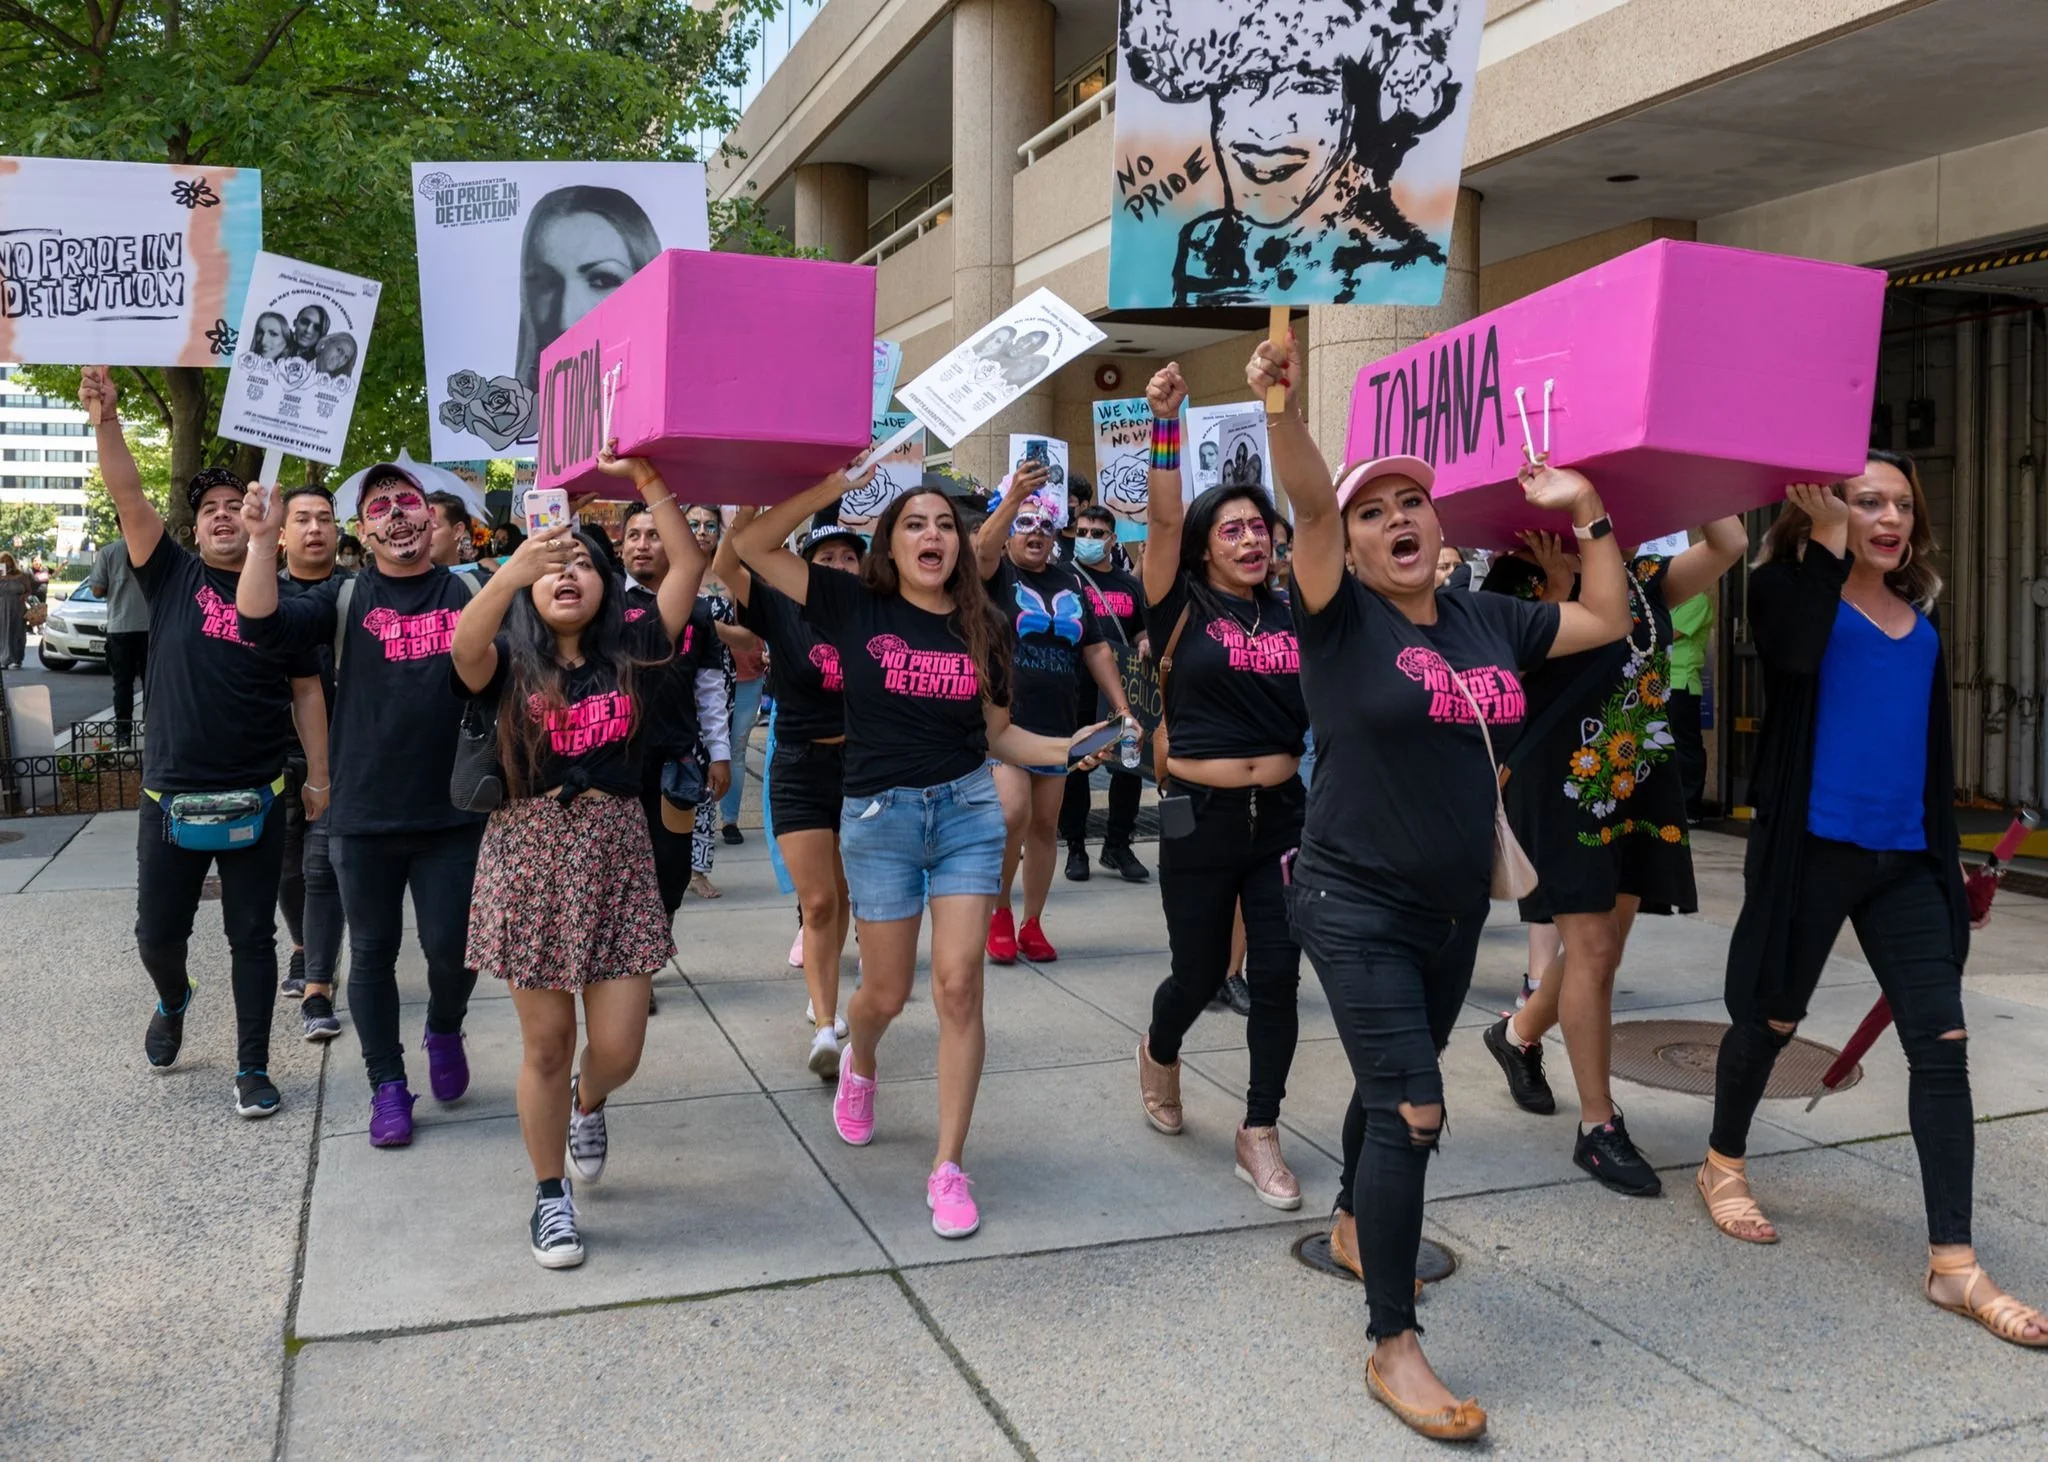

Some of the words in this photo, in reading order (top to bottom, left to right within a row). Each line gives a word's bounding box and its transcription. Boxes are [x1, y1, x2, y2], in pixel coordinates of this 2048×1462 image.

[1116, 153, 1154, 195] NO
[1123, 145, 1211, 223] PRIDE
[436, 190, 454, 206] NO
[457, 184, 499, 204] PRIDE
[502, 182, 517, 199] IN
[436, 199, 517, 224] DETENTION
[40, 236, 138, 279] PRIDE
[142, 232, 182, 271] IN
[1, 271, 184, 318] DETENTION
[1097, 404, 1121, 420] WE
[1127, 402, 1150, 414] WA
[233, 424, 332, 454] #ENDTRANSDETENTION
[202, 615, 239, 638] DETE
[380, 622, 401, 641] NO
[402, 614, 445, 638] PRIDE
[385, 630, 455, 659] DETENTIO
[1223, 632, 1244, 648] NO
[821, 659, 838, 674] NO
[880, 651, 907, 669] NO
[908, 655, 960, 675] PRIDE
[1229, 648, 1300, 670] DETENTIO
[885, 669, 978, 696] DETENTION
[1424, 668, 1449, 691] NO
[1497, 670, 1521, 692] IN
[614, 694, 631, 718] IN
[550, 717, 631, 752] DTENTION
